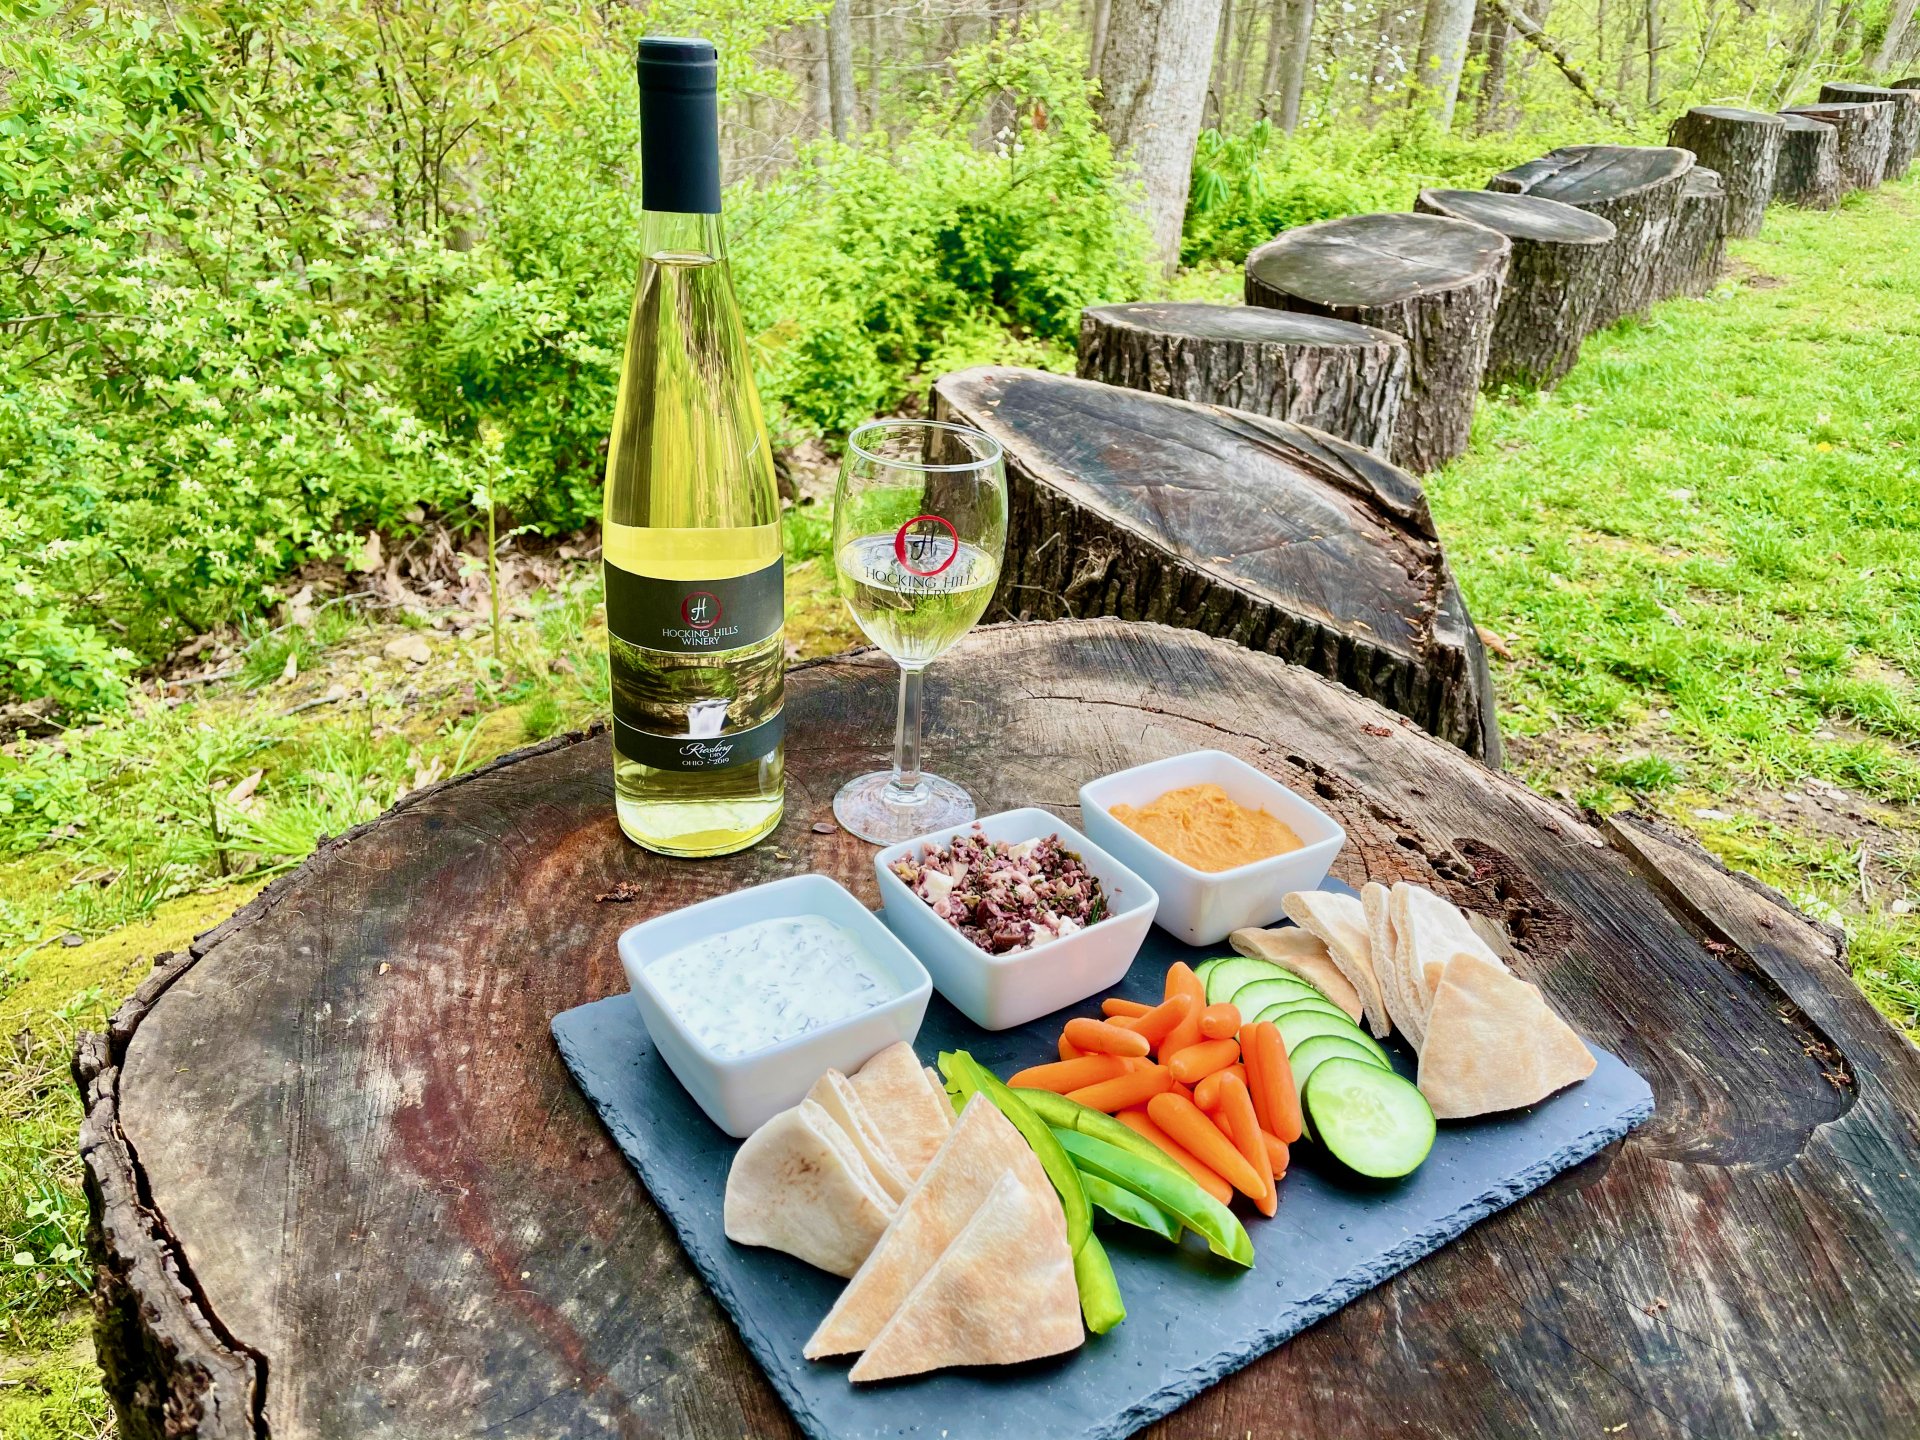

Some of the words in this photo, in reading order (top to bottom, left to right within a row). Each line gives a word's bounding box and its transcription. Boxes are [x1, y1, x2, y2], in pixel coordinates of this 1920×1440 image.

[911, 523, 936, 560] H
[866, 567, 937, 588] HOCKING
[690, 597, 708, 621] H
[662, 628, 710, 638] HOCKING
[714, 625, 739, 637] HILLS
[682, 636, 720, 646] WINERY
[679, 739, 734, 761] Riesling
